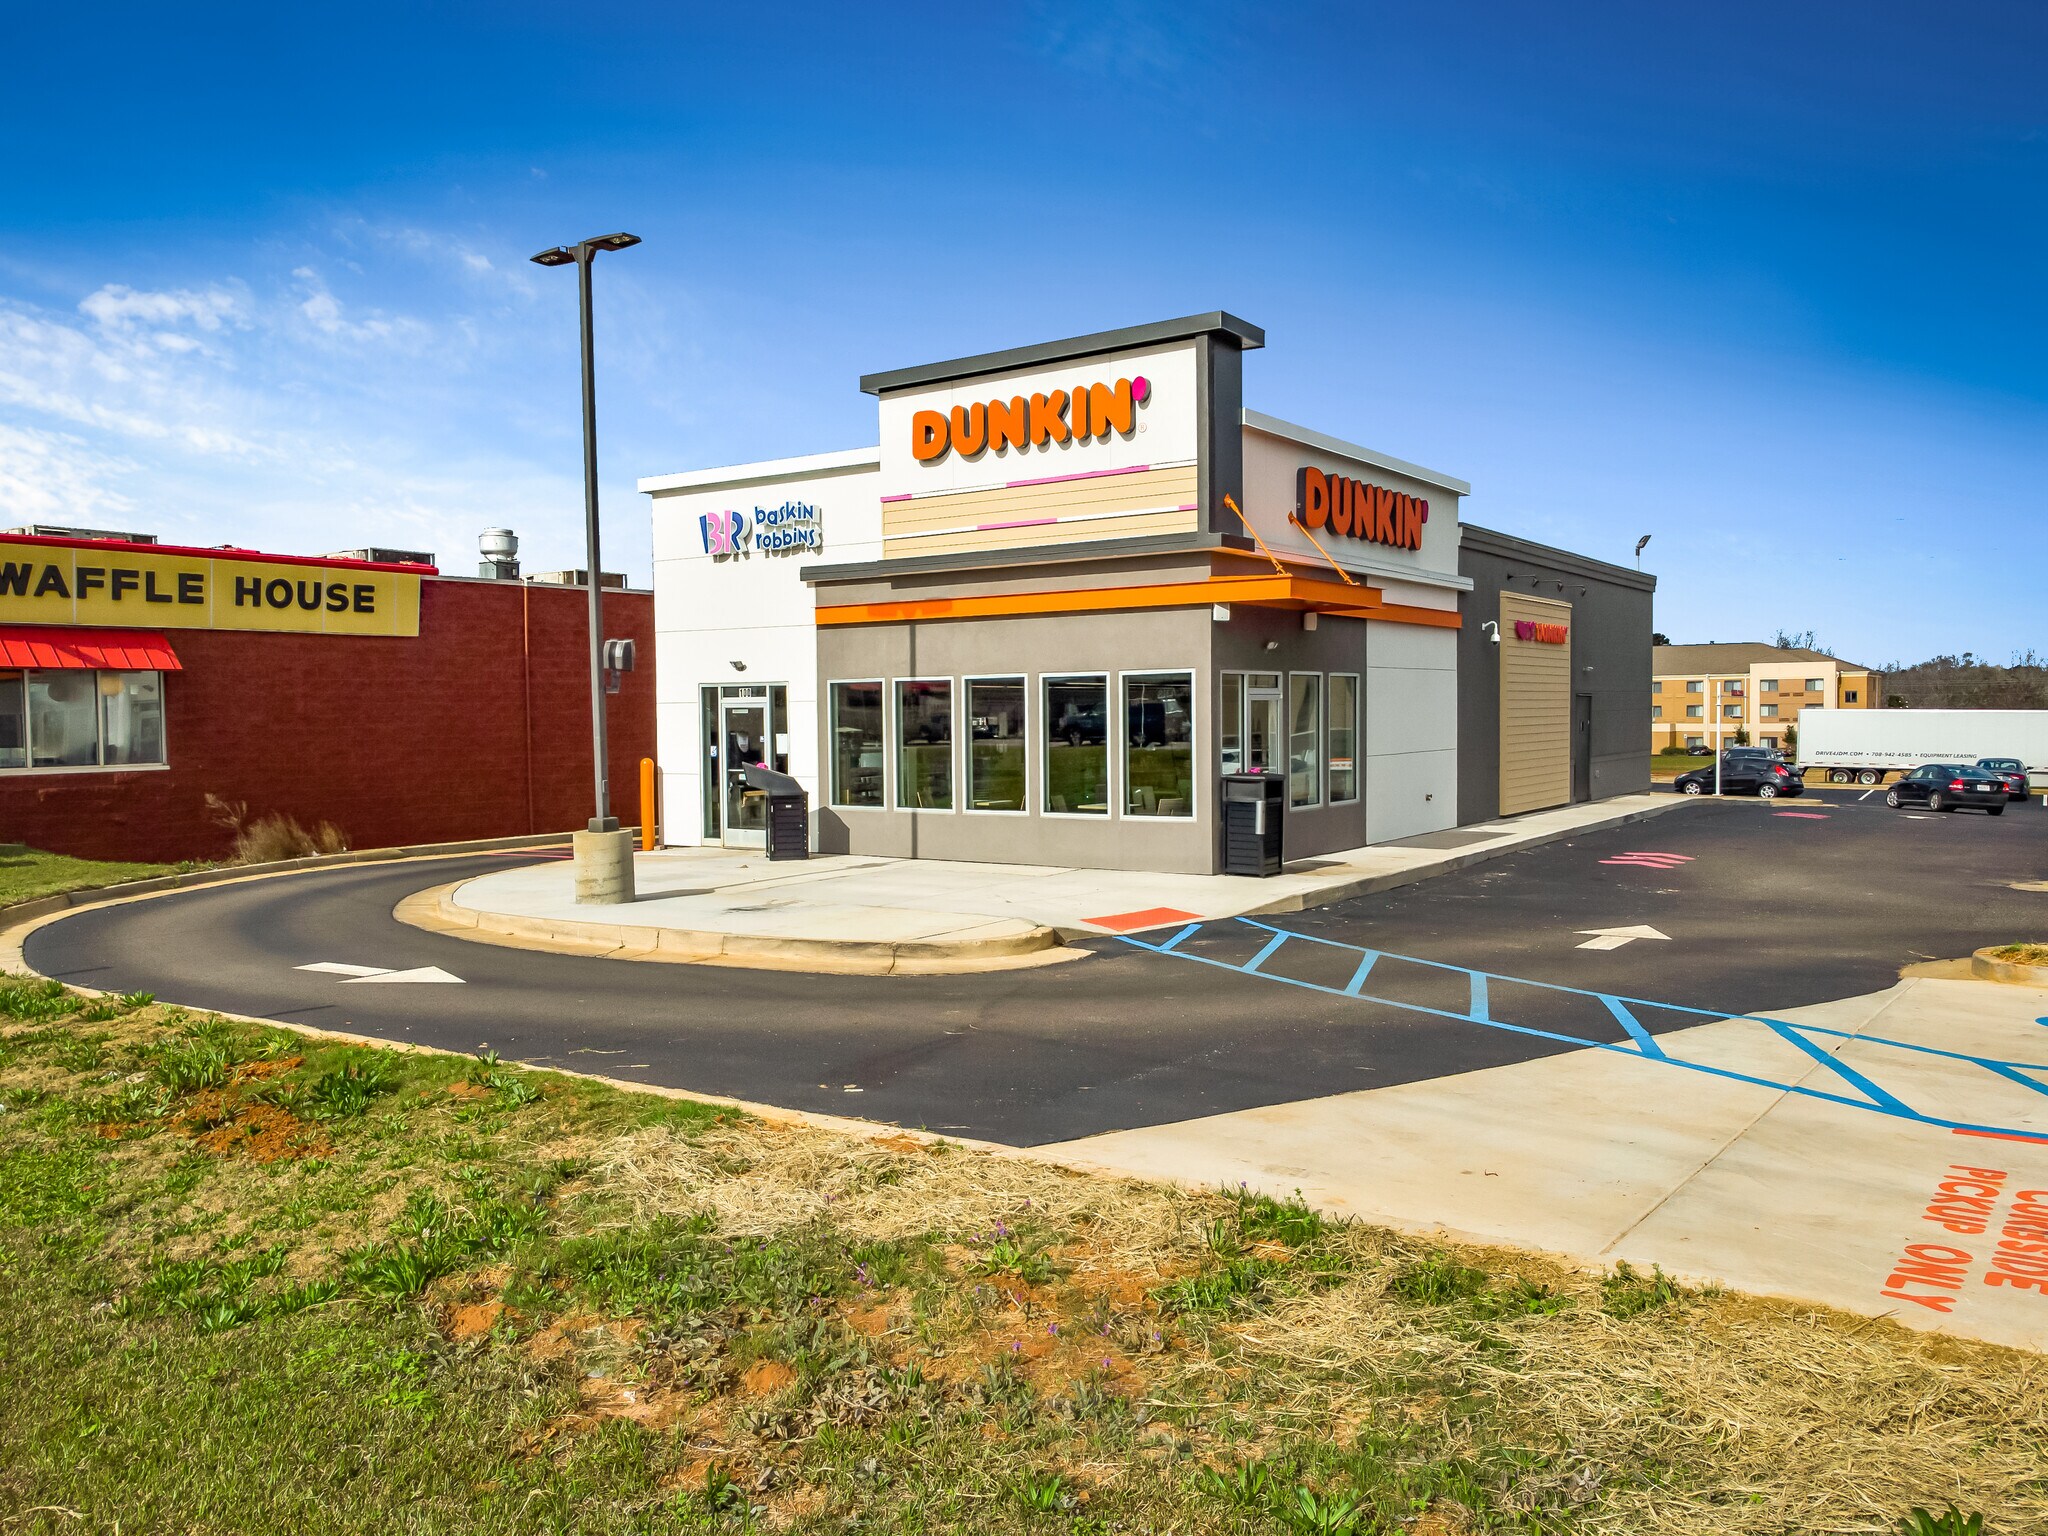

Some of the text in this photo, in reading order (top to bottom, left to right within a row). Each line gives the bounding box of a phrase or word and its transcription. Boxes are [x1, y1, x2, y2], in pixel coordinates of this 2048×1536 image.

[912, 376, 1148, 461] DUNKIN'
[754, 501, 815, 525] baskin
[1304, 466, 1429, 551] DUNKIN'
[755, 528, 816, 549] robbins
[0, 563, 375, 613] WAFFLE HOUSE
[739, 688, 751, 698] 100
[1880, 1165, 2008, 1312] PICKUP ONLY
